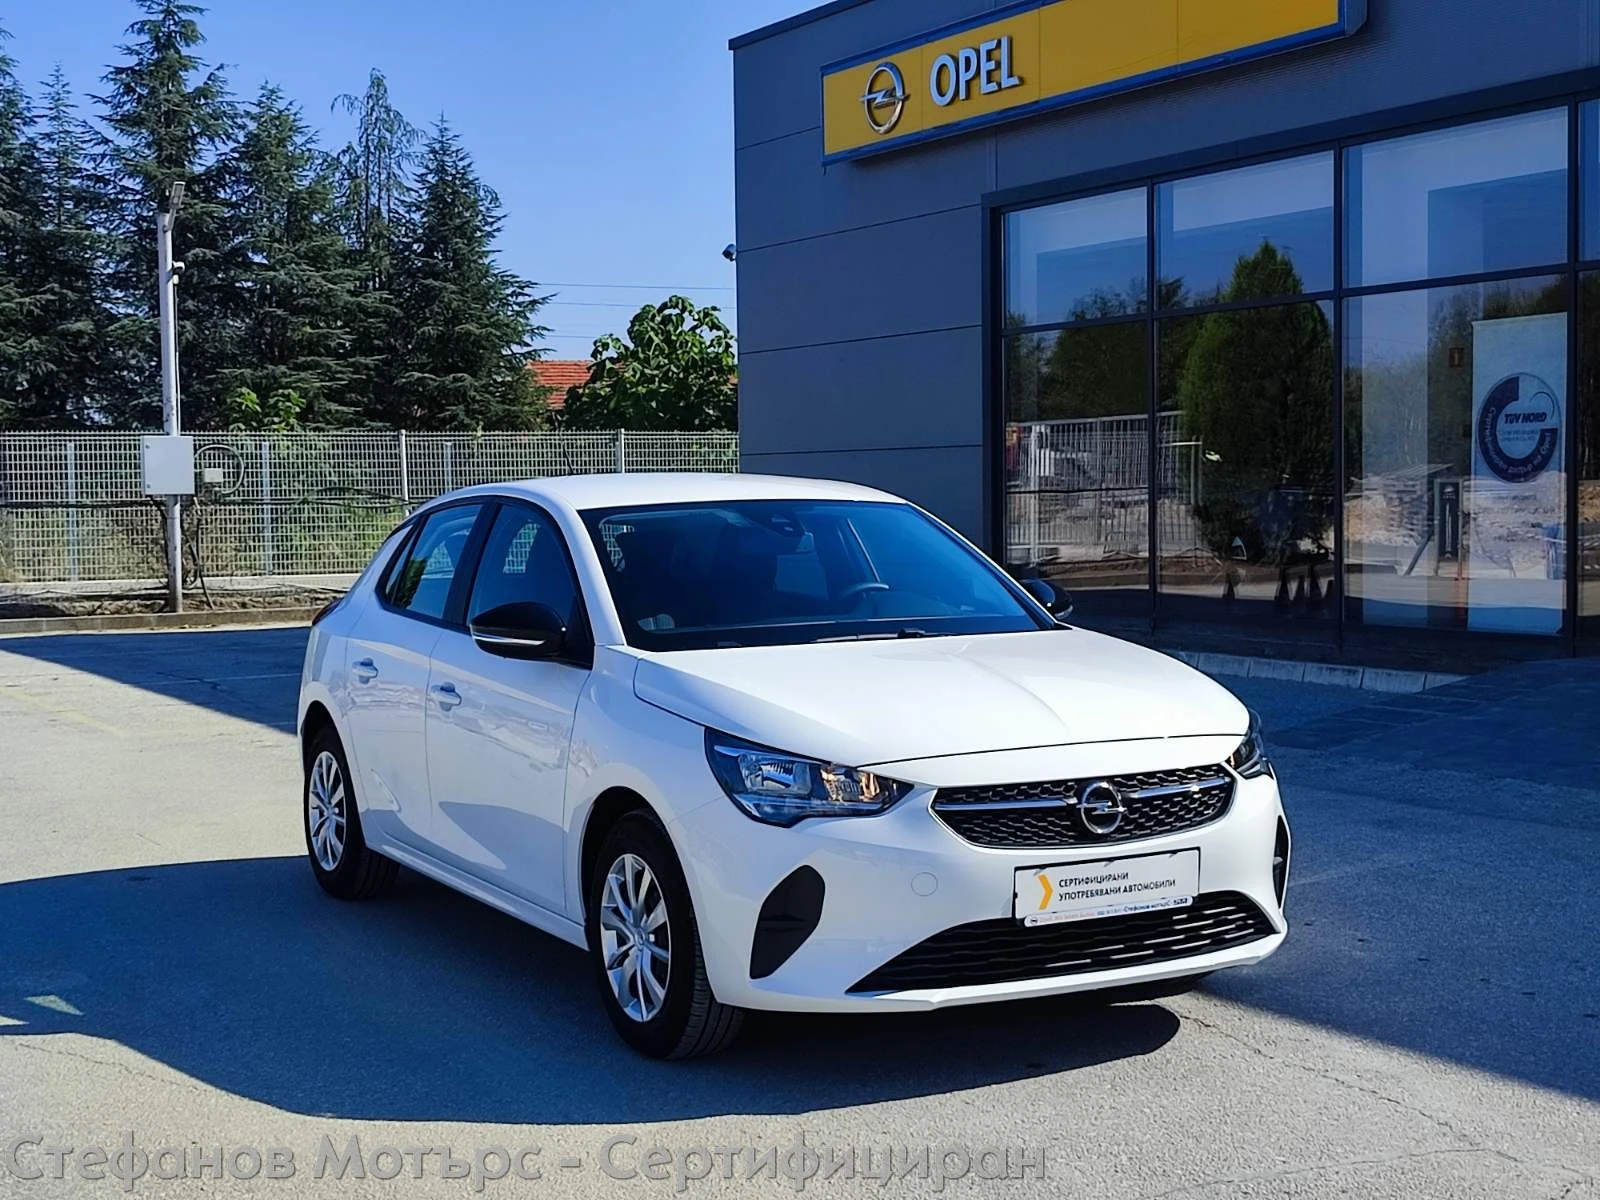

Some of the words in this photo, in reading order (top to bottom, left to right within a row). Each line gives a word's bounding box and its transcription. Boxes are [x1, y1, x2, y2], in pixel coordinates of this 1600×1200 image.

[930, 36, 1021, 106] OPEL
[1520, 412, 1547, 423] NORD
[1059, 872, 1129, 887] СЕРТИФИЦИРАНИ
[1059, 888, 1122, 901] УПОТРЕБЯВАНИ
[1122, 879, 1176, 893] АВТОМОБИЛИ
